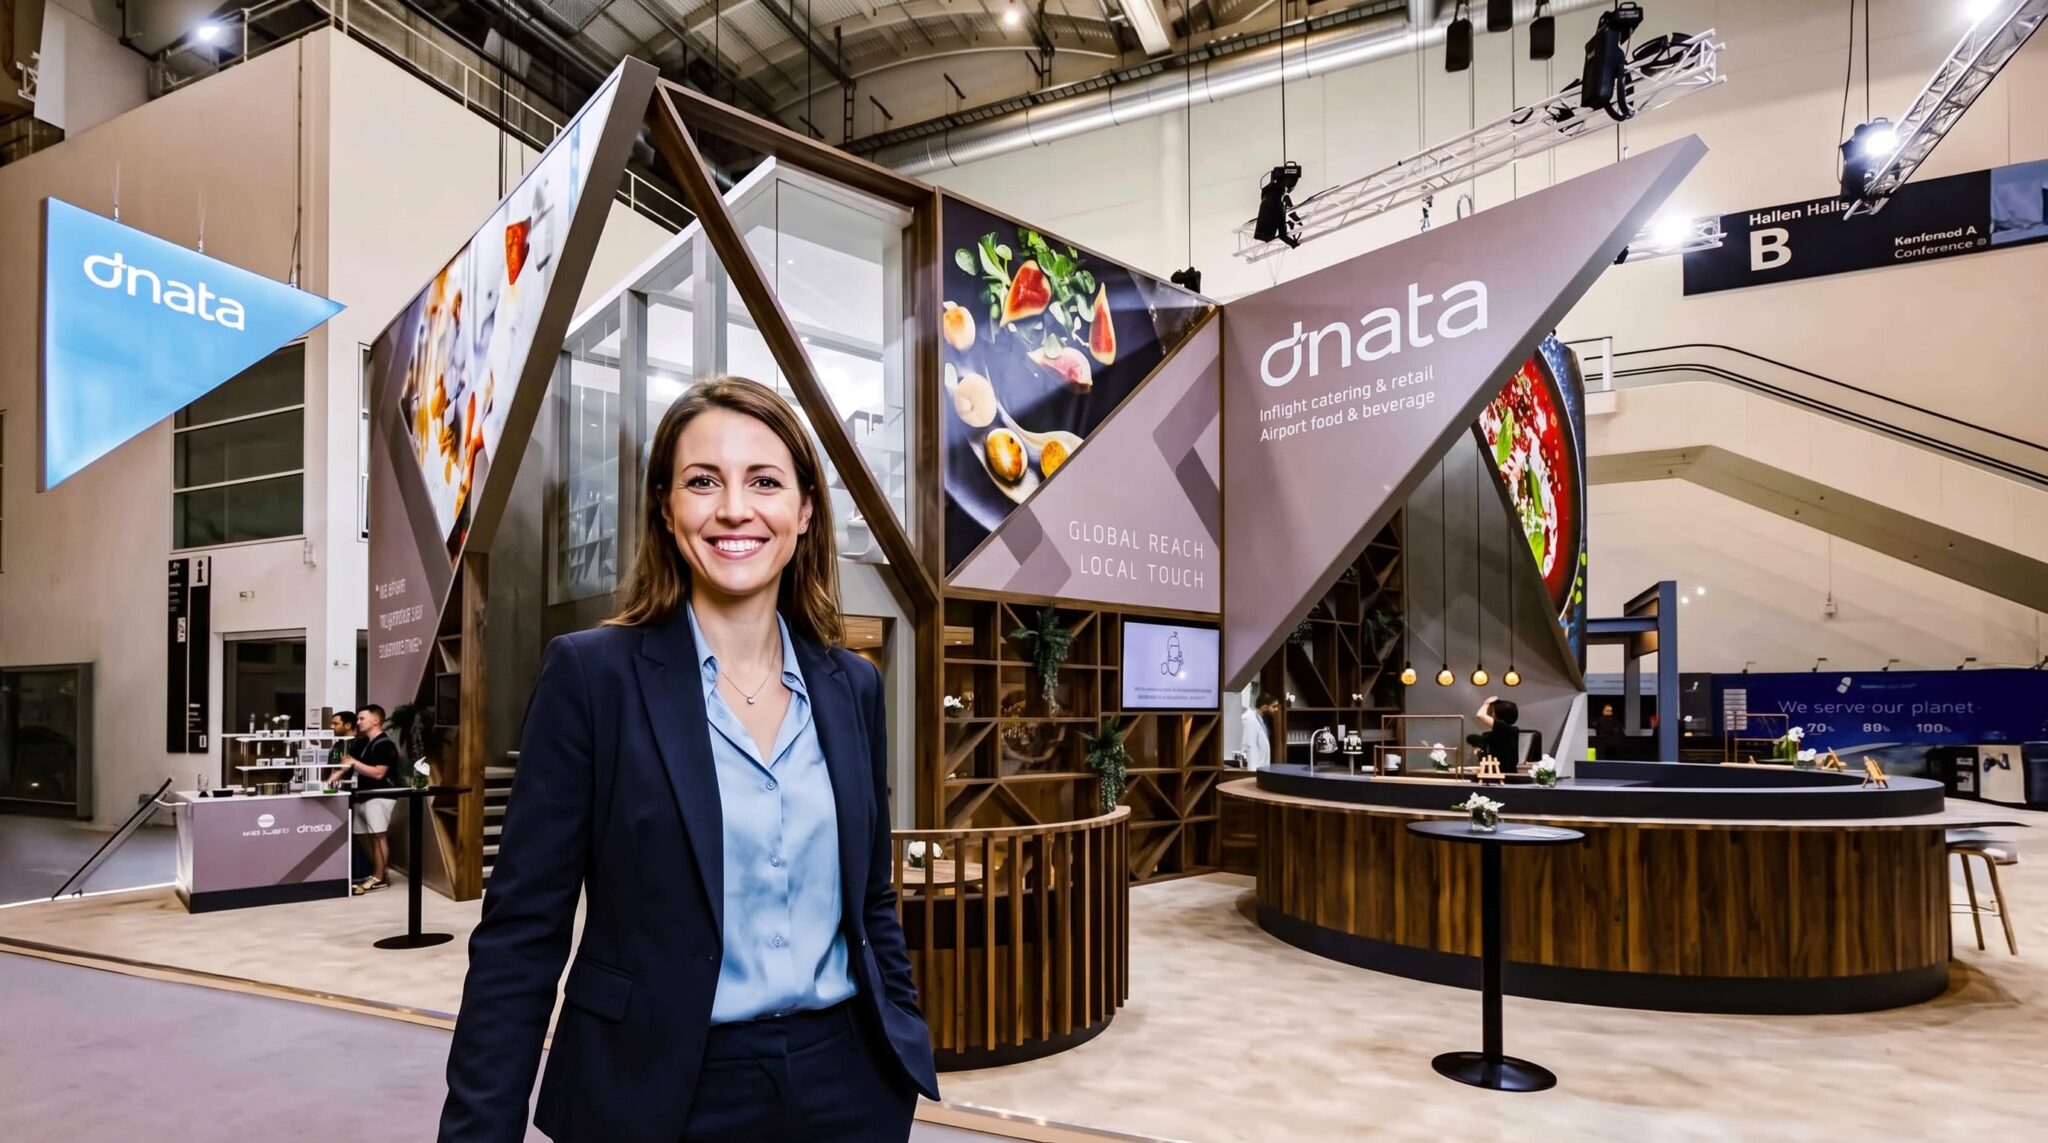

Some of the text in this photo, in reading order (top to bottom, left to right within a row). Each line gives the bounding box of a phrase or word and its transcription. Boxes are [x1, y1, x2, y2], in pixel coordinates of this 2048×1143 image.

[1749, 200, 1850, 226] Hallen Halls
[1966, 225, 1978, 235] A
[1750, 227, 1792, 272] B
[1894, 240, 1974, 259] Conference
[83, 252, 246, 331] dnata
[1260, 280, 1488, 387] dnata
[1260, 365, 1434, 422] Inflight catering & retail
[1260, 391, 1435, 442] Airport food & beverage
[1069, 520, 1204, 559] GLOBAL REACH
[1080, 555, 1204, 589] LOCAL TOUCH
[1777, 700, 1975, 717] We serve our planet
